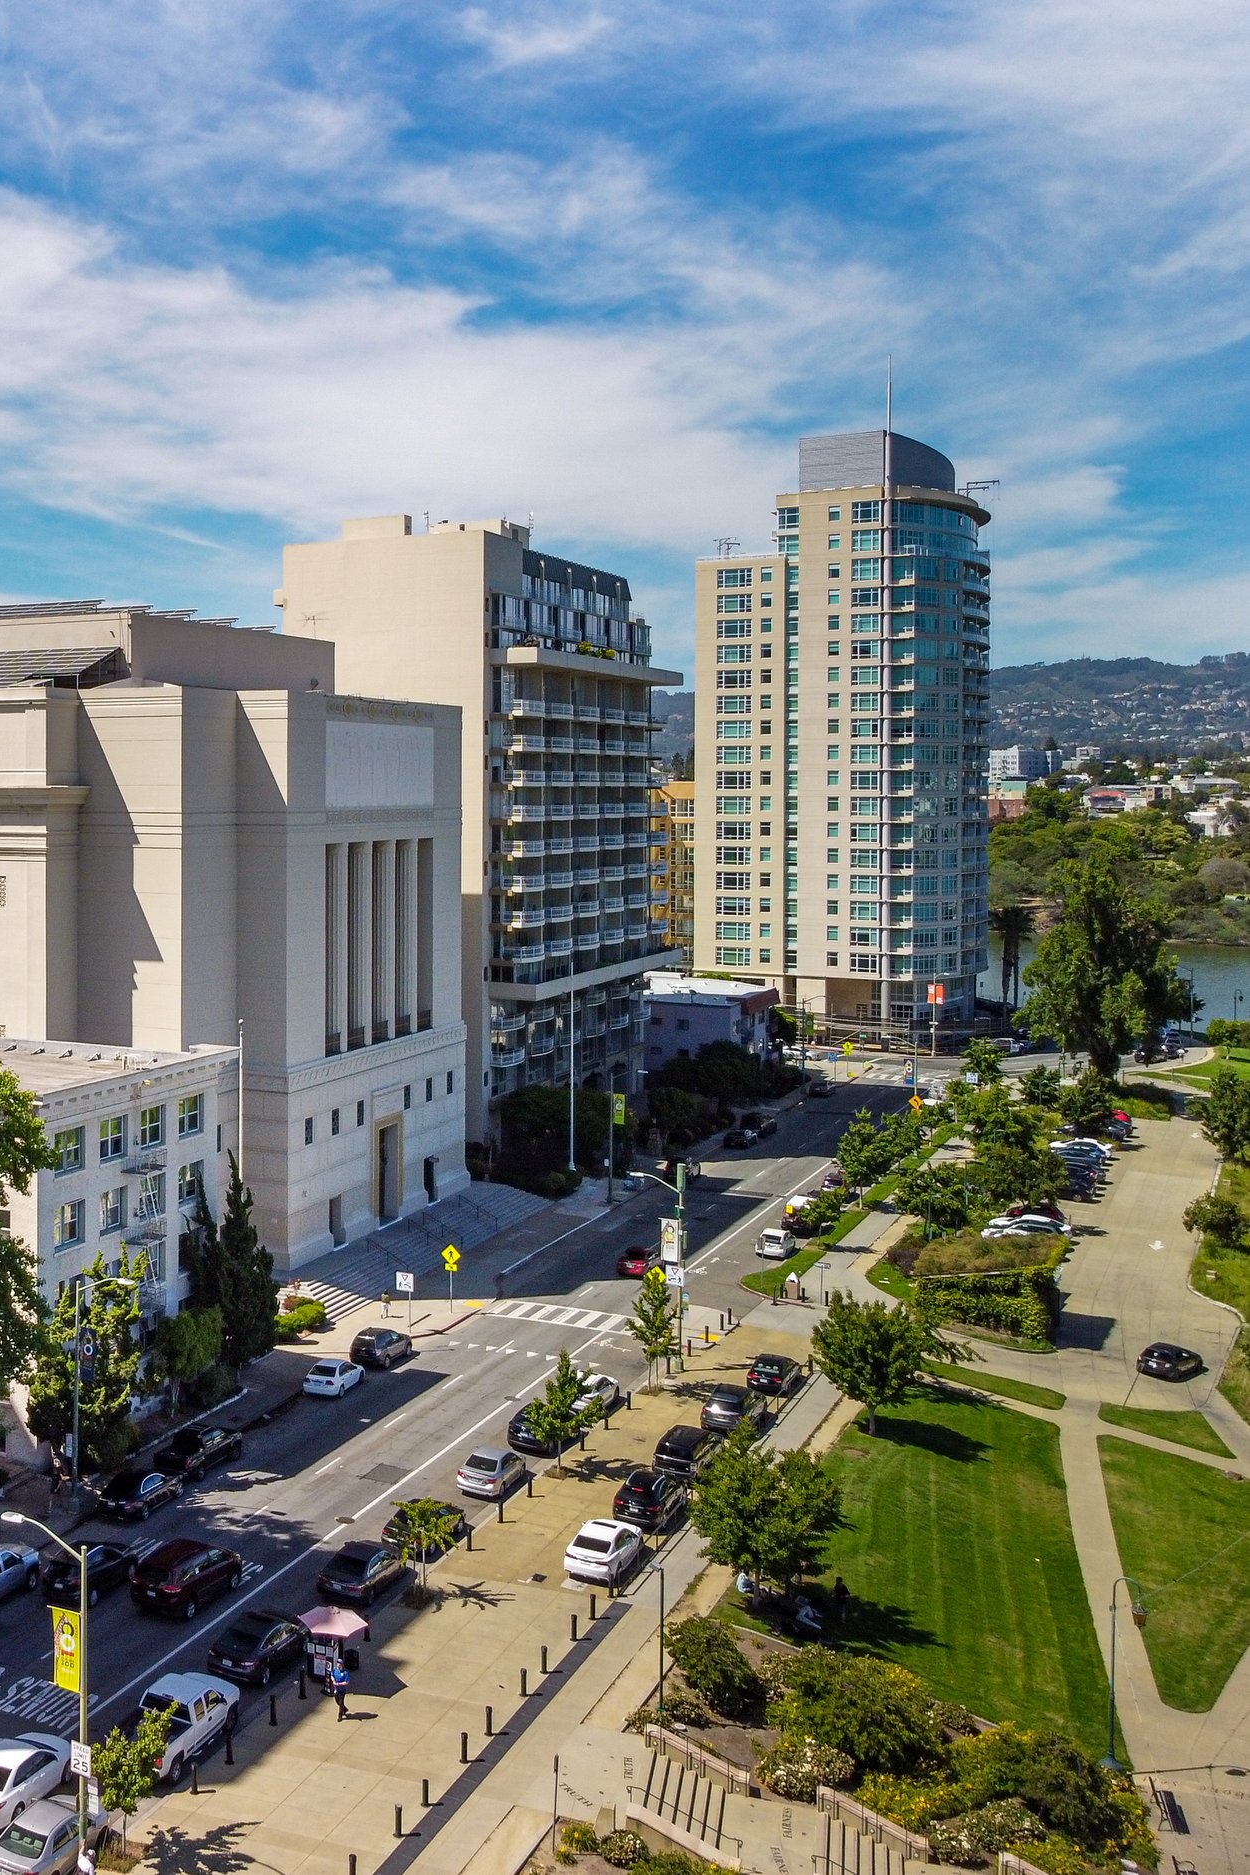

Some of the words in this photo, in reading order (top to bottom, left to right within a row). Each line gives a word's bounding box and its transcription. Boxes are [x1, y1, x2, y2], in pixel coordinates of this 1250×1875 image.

[73, 1743, 90, 1755] SPEED
[74, 1751, 87, 1760] LIMIT
[73, 1758, 89, 1773] 25
[623, 1756, 634, 1780] TRUTH
[559, 1782, 593, 1807] TRUTH
[781, 1806, 793, 1839] FAIRNESS
[770, 1846, 790, 1875] FAIRNE
